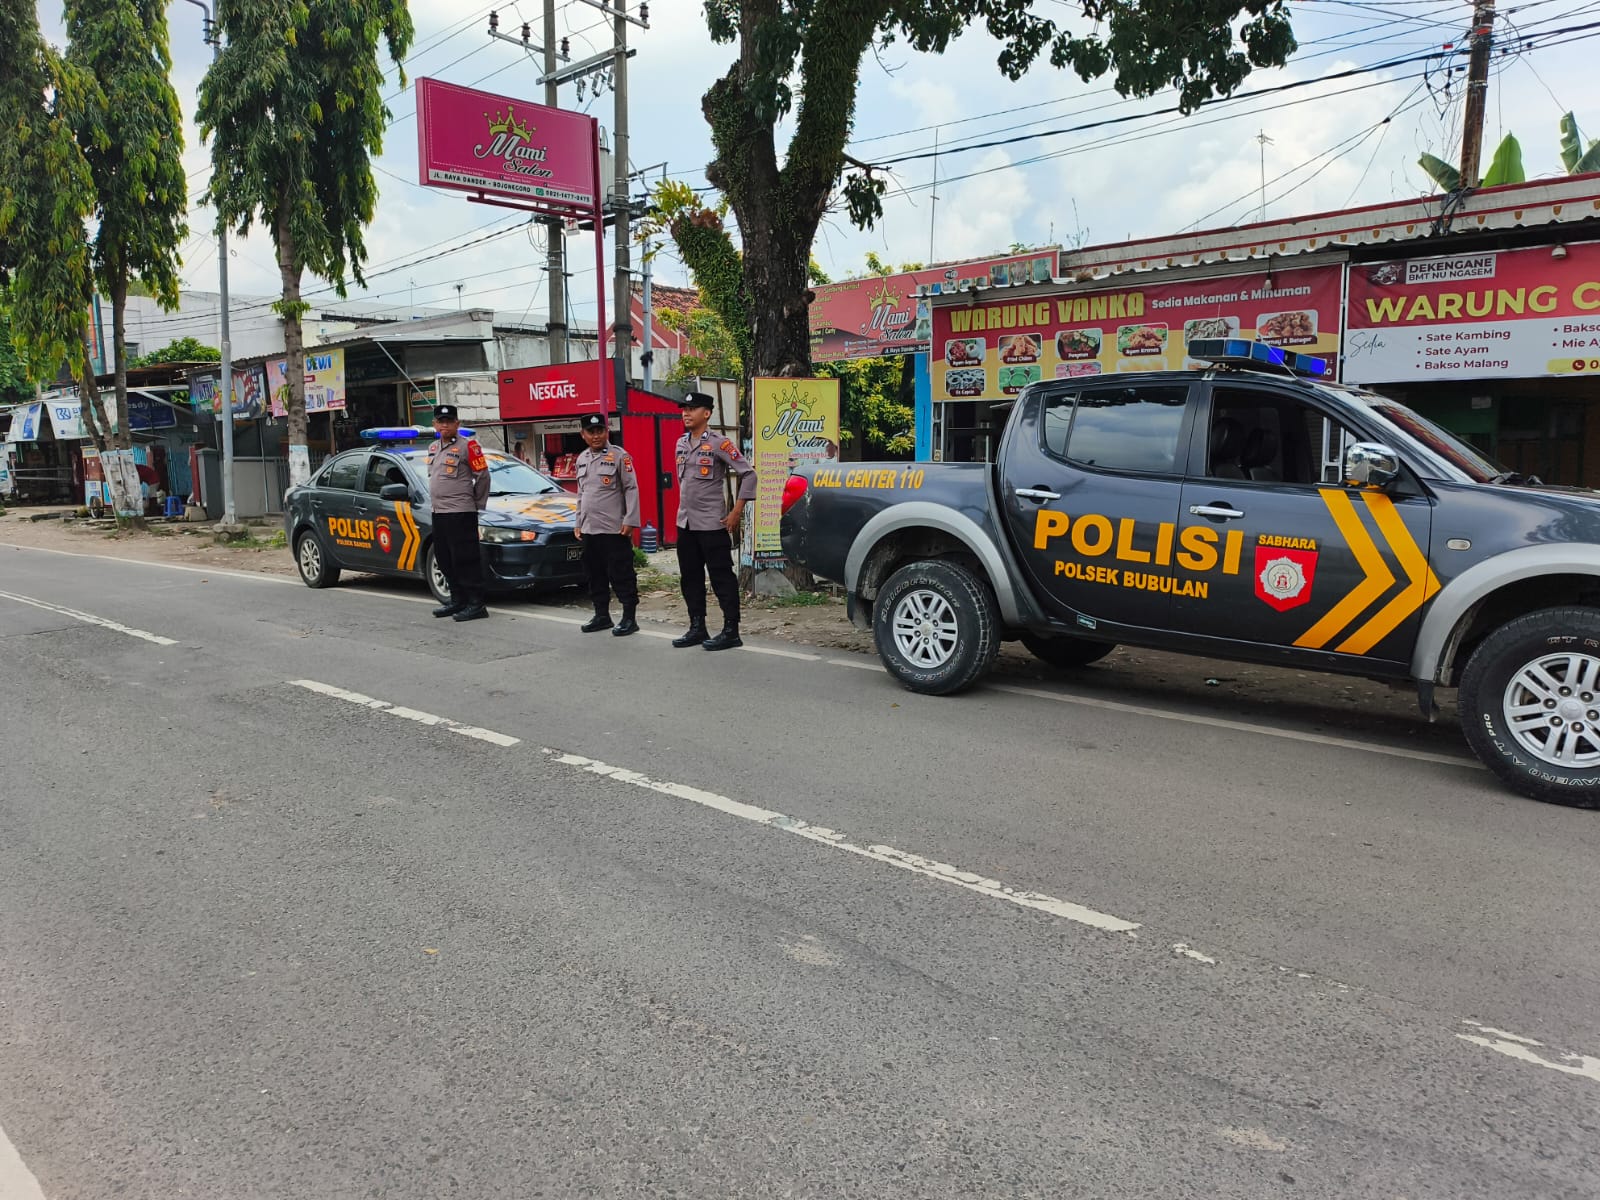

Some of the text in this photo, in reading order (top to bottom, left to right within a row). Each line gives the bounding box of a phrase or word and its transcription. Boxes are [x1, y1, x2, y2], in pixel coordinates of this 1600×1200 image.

[474, 133, 548, 161] Mami
[445, 173, 461, 182] RAYA
[503, 160, 553, 178] Salon
[1408, 267, 1494, 281] BMT NU NGASEM
[1409, 258, 1493, 274] DEKENGANE
[1152, 285, 1311, 309] Sedia Makanan & Minuman
[1365, 285, 1558, 323] WARUNG
[861, 305, 911, 336] Mami
[950, 292, 1144, 333] WARUNG VANKA
[879, 327, 914, 341] Salon
[1426, 329, 1511, 342] Sate Kambing
[1562, 338, 1585, 348] Mie
[1350, 331, 1386, 358] Sedia
[1425, 345, 1489, 357] Sate Ayam
[1425, 358, 1509, 371] Bakso Malang
[762, 409, 826, 441] Mami
[786, 434, 829, 449] Salon
[813, 469, 925, 489] CALL CENTER 110
[328, 516, 375, 541] POLISI
[1033, 508, 1245, 575] POLISI
[1258, 534, 1317, 550] SABHARA
[1054, 560, 1209, 599] POLSEK BUBULAN
[1483, 713, 1497, 737] PRO
[1528, 767, 1600, 786] AVERO
